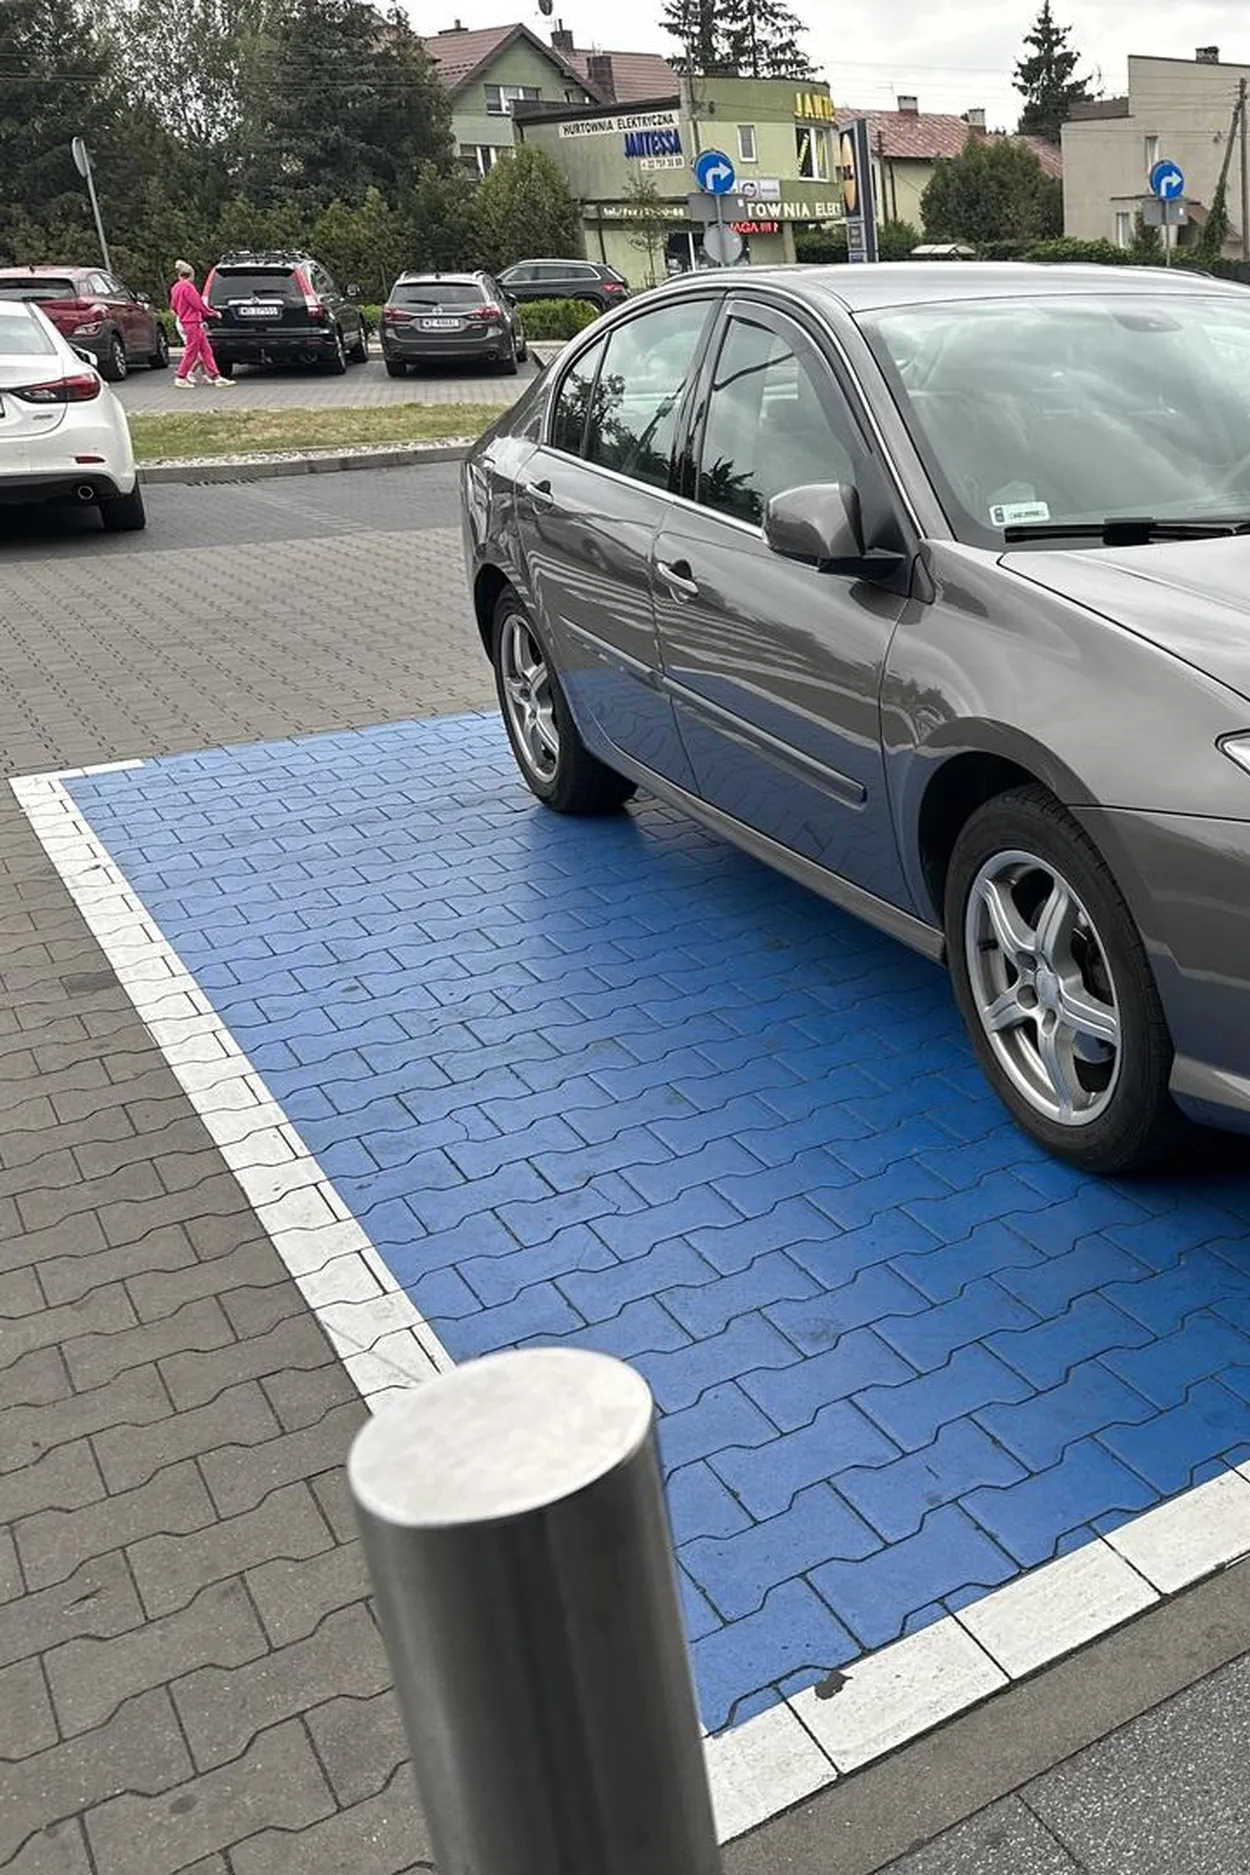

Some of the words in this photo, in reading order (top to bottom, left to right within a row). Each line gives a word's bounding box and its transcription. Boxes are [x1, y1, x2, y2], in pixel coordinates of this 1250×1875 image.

[563, 119, 615, 137] HURTOWNIA
[616, 113, 674, 131] ELEKTRYCZNA
[624, 127, 683, 160] JANTESSA
[746, 201, 811, 218] TOWNIA
